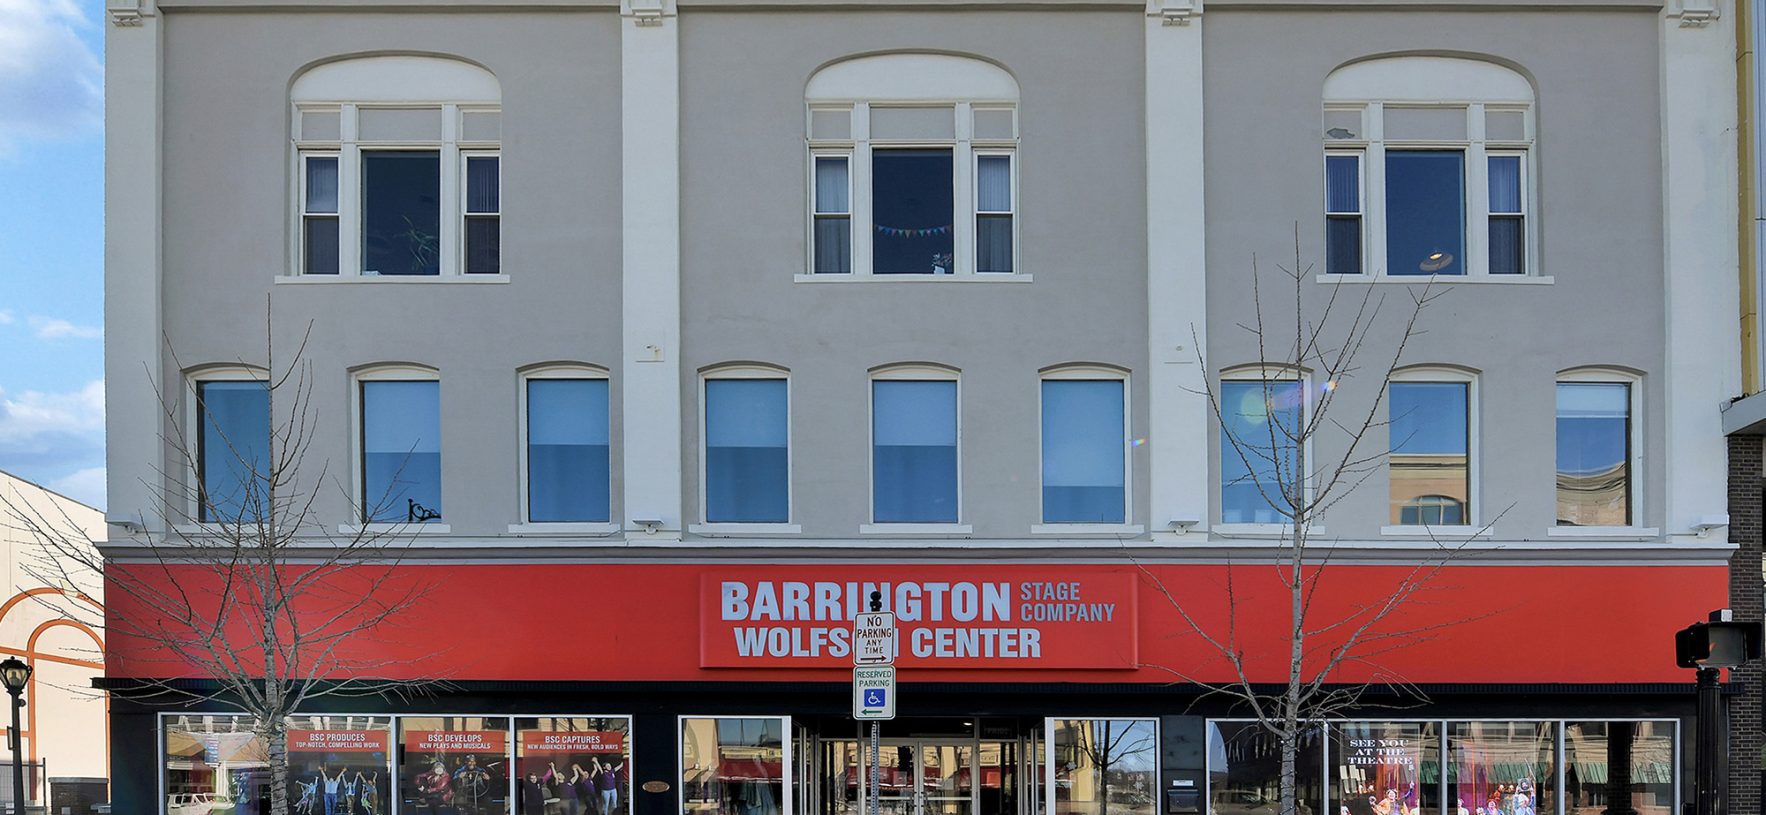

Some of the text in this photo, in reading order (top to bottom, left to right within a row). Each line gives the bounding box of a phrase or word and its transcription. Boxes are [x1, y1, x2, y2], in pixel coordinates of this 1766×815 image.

[1020, 582, 1080, 600] STAGE
[721, 581, 1010, 622] BARRINGTON
[1020, 603, 1115, 622] COMPANY
[867, 617, 882, 627] NO
[857, 628, 892, 639] PARKING
[733, 627, 1041, 658] WOLFS CENTER
[866, 639, 882, 647] ANY
[865, 647, 883, 655] TIME
[857, 671, 892, 679] RESERVED
[859, 680, 890, 688] PARKING
[309, 733, 365, 741] BSC PRODUCES
[428, 734, 482, 742] BSC DEVELOPS
[545, 735, 601, 744] BSC CAPTURES
[296, 741, 380, 749] TOP-NOTCH, COMPELLING WORK
[419, 742, 491, 750] NEW PLAYS AND MUSICALS
[1350, 739, 1409, 747] SEE YOU
[1355, 748, 1405, 756] AT THE
[1347, 757, 1413, 765] THEATRE
